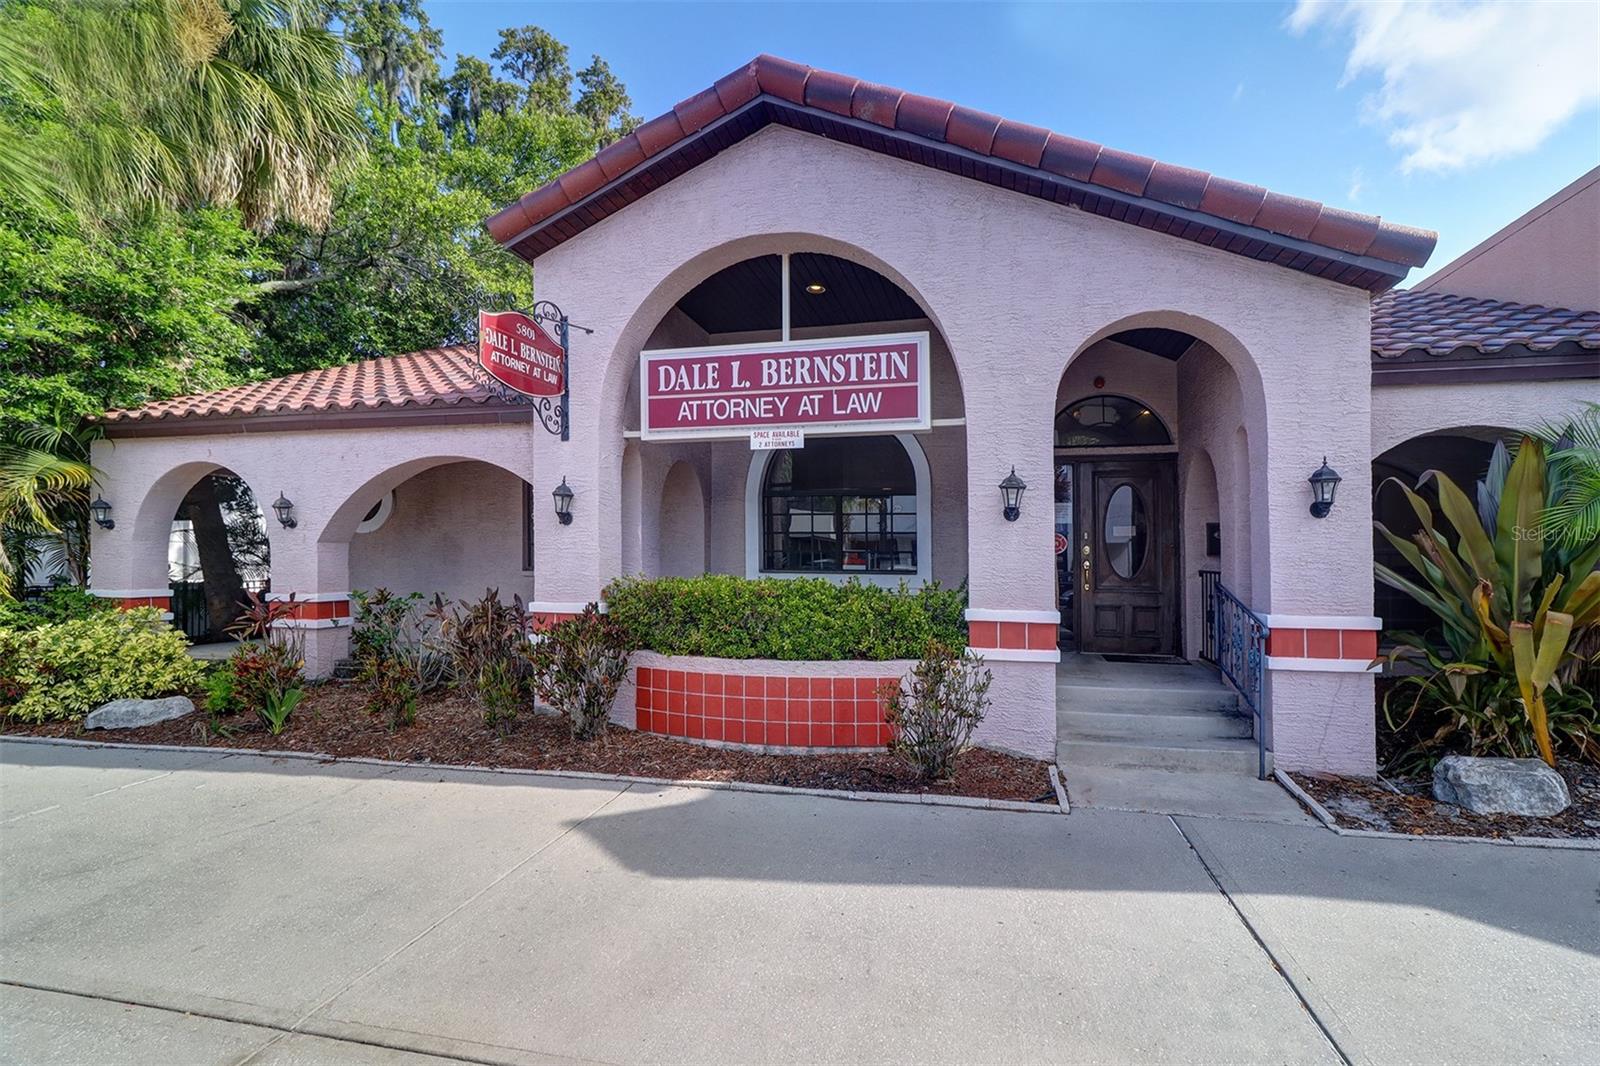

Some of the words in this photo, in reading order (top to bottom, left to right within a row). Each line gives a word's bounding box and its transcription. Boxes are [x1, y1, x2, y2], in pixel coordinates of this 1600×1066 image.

[516, 323, 536, 340] 5801
[485, 328, 508, 351] DALE
[520, 343, 561, 372] BERNSTEIN
[491, 351, 531, 374] ATTORNEY
[533, 367, 541, 378] AT
[543, 370, 558, 385] LAW
[658, 362, 719, 392] DALE
[731, 360, 751, 389] L.
[761, 351, 910, 387] BERNSTEIN
[677, 397, 789, 422] ATTORNEY
[798, 395, 823, 416] AT
[832, 392, 883, 415] LAW
[772, 430, 800, 438] AVAILABLE
